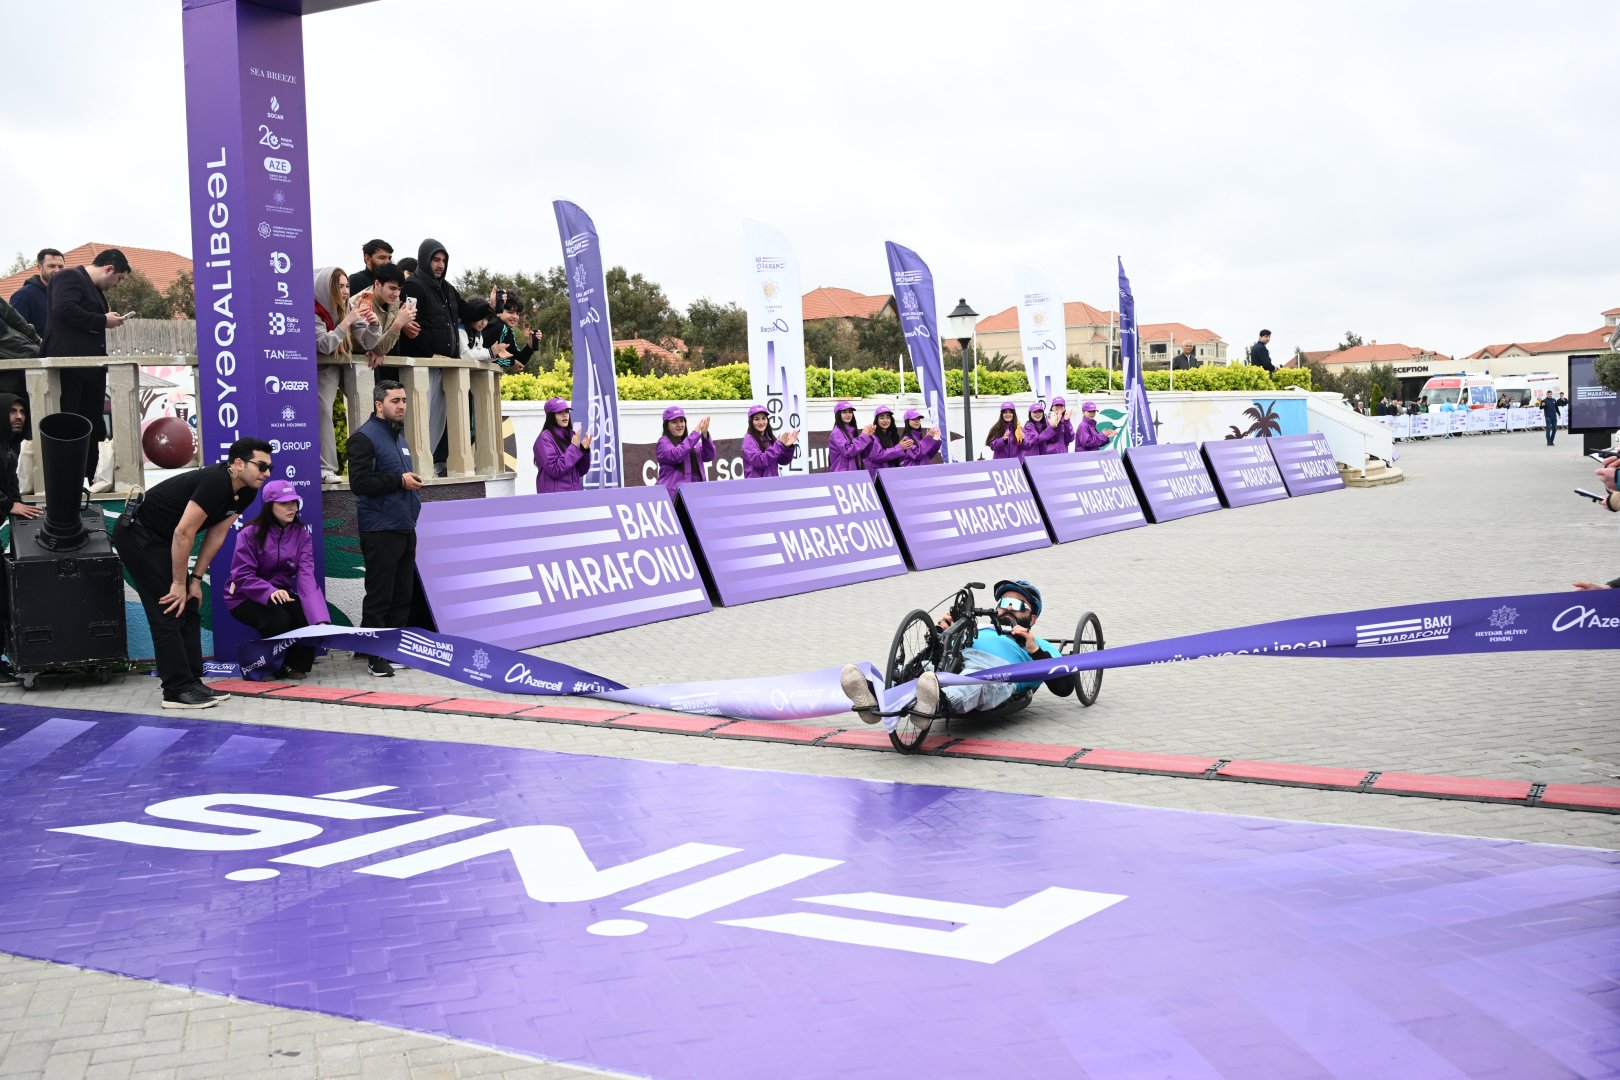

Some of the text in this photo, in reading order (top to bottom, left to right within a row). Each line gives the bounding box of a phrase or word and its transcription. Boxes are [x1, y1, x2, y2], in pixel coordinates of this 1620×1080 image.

[250, 67, 297, 84] SEA BREEZE
[267, 112, 284, 120] SOCAR
[269, 160, 287, 171] AZE
[263, 349, 285, 359] TAN
[282, 441, 312, 451] GROUP
[1313, 439, 1333, 456] BAKI
[1101, 458, 1126, 481] BAKI
[1300, 458, 1338, 478] MARAFONU
[991, 468, 1031, 496] BAKI
[833, 482, 882, 515] BAKI
[1079, 485, 1138, 514] MARAFONU
[615, 500, 679, 541] BAKI
[953, 499, 1041, 535] MARAFONU
[779, 518, 895, 562] MARAFONU
[537, 544, 695, 603] MARAFONU
[1424, 616, 1452, 629] BAKI
[1381, 627, 1451, 644] MARAFONU
[411, 642, 453, 662] MARAFONU
[435, 641, 454, 652] BAKI
[525, 676, 562, 692] Azercell
